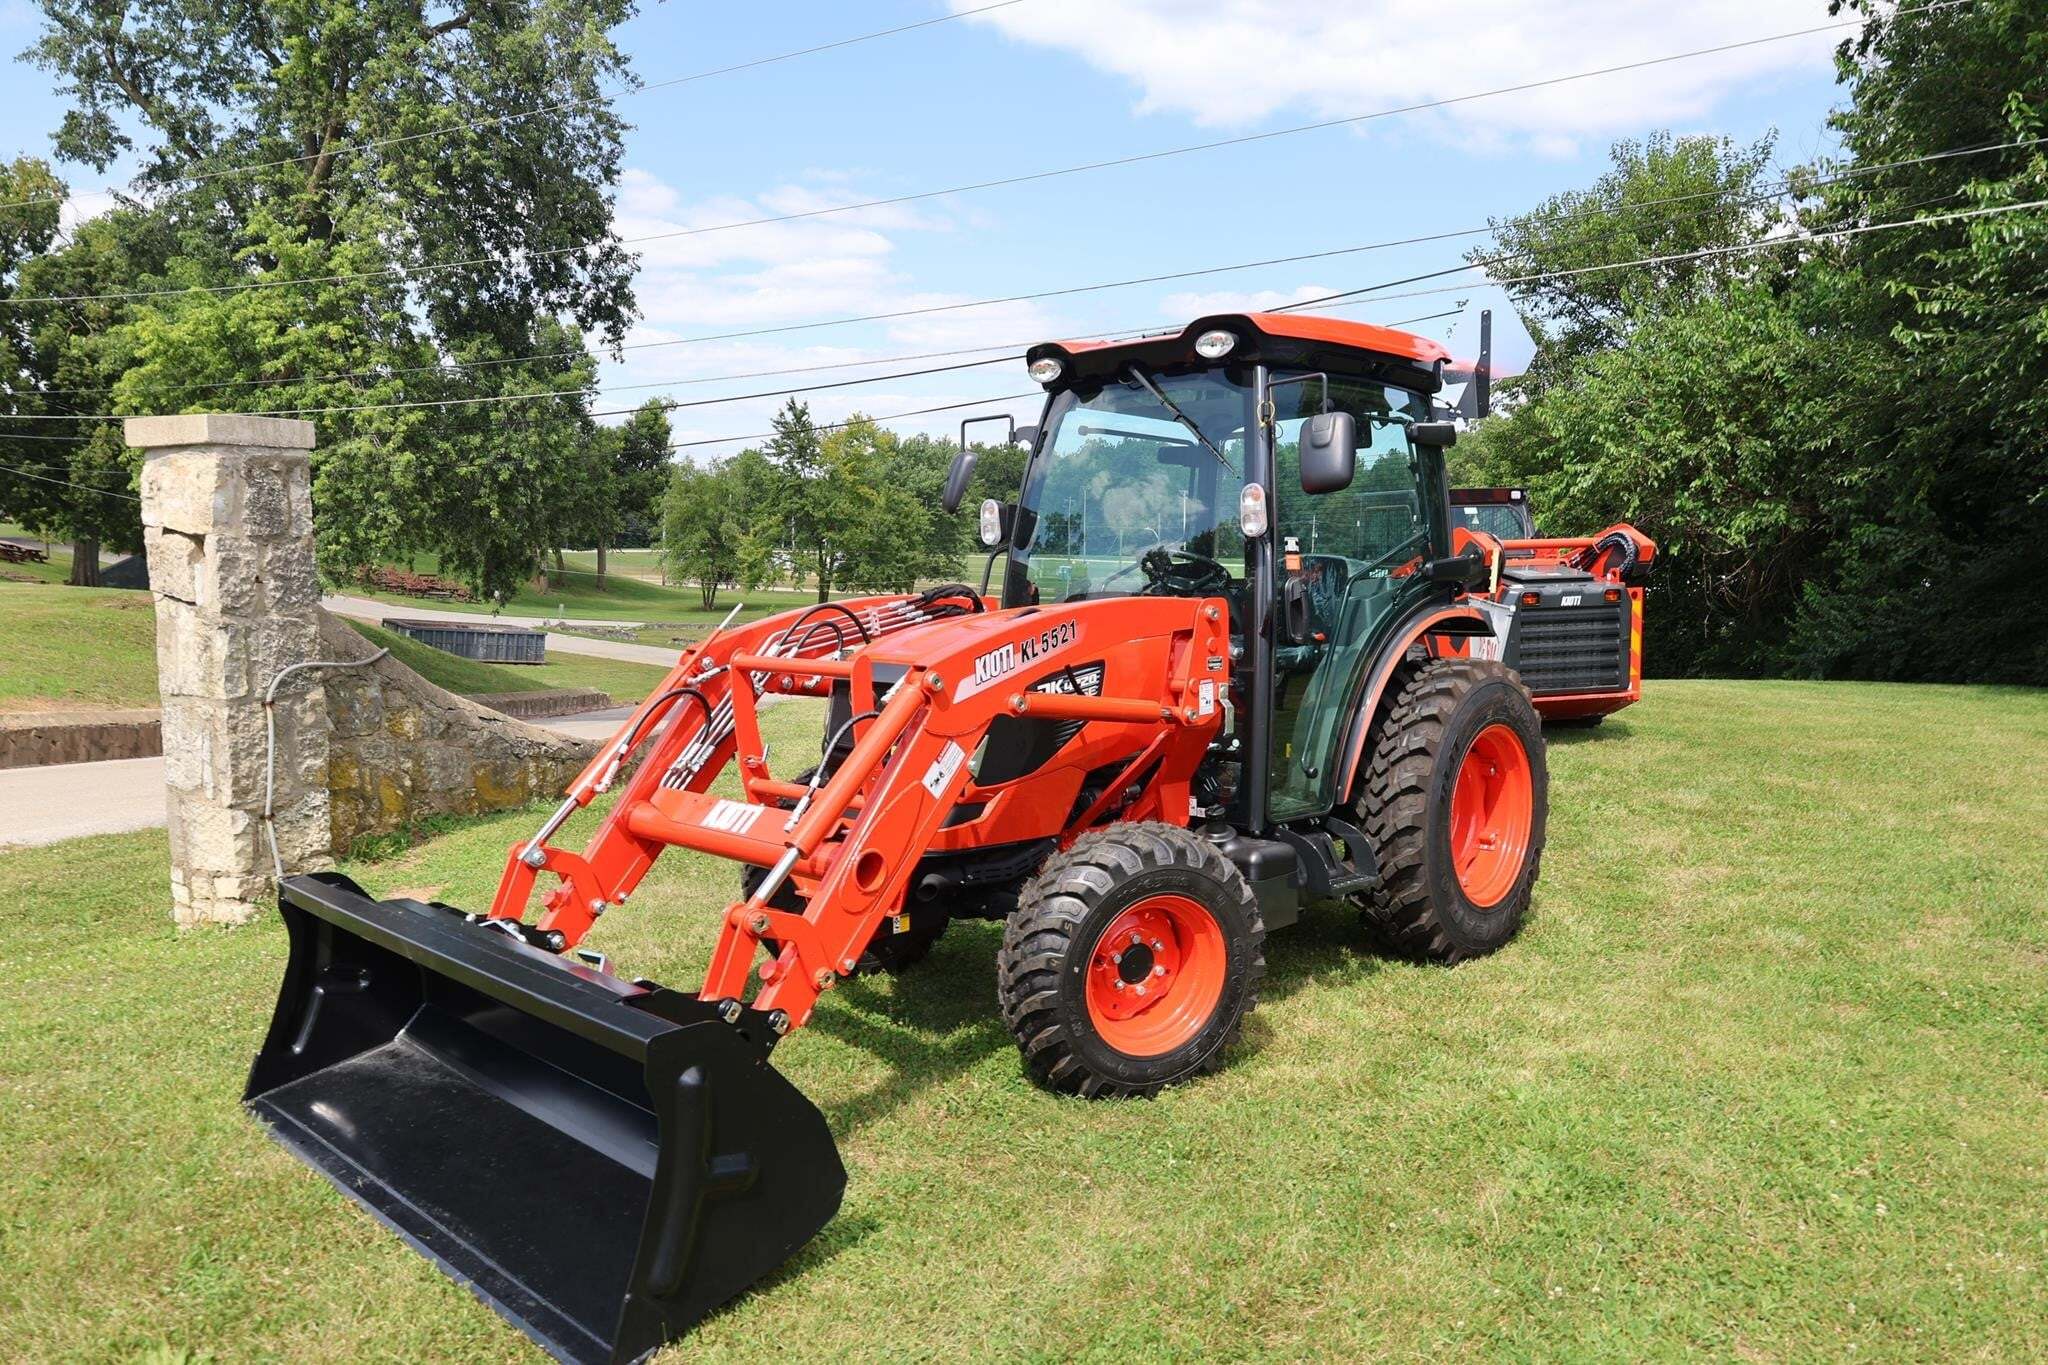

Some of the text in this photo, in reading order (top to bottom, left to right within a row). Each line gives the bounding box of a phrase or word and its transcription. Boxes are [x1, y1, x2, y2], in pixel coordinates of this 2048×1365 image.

[974, 619, 1076, 686] KIOTI KL 5521
